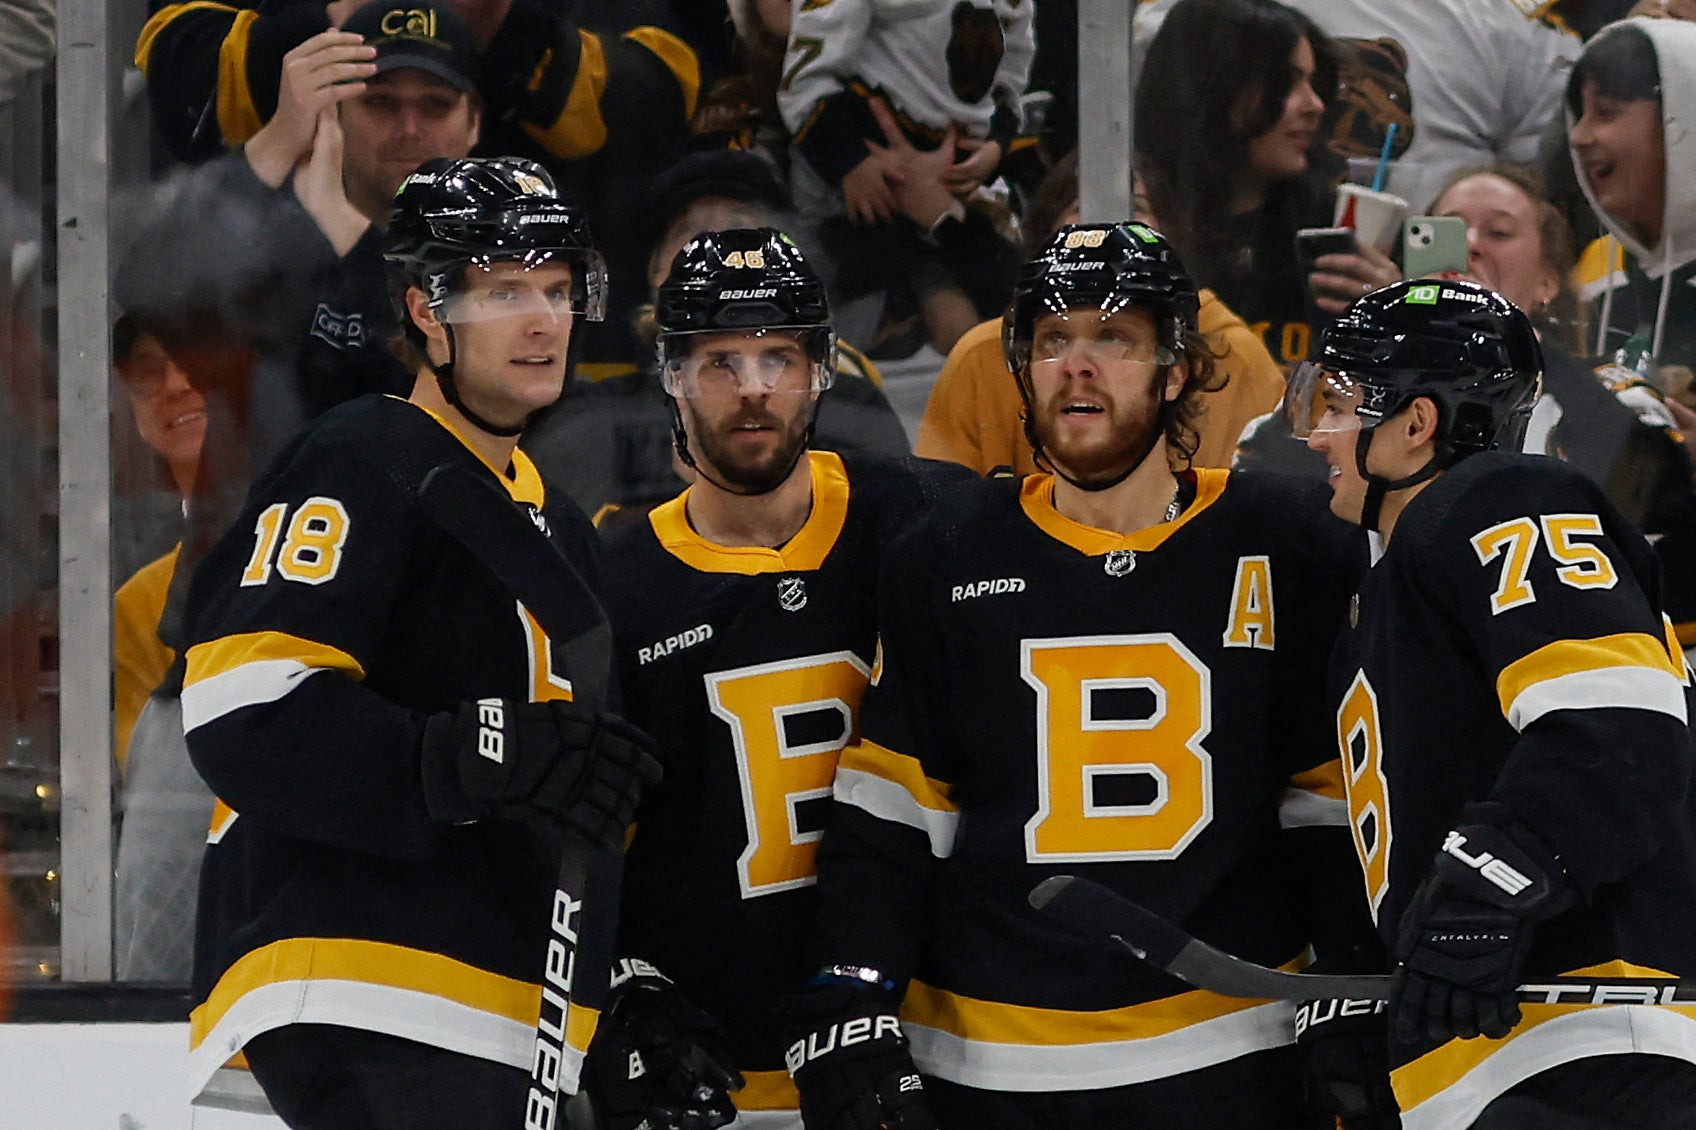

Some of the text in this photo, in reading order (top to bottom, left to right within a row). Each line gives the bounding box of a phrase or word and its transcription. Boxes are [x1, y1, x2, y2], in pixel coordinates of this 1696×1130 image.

[381, 8, 438, 38] cal
[1064, 229, 1107, 249] 88
[724, 250, 766, 270] 46
[1048, 261, 1106, 273] BAUER
[718, 288, 778, 300] BAUER
[1441, 288, 1490, 306] Bank
[239, 496, 351, 588] 18
[1469, 513, 1619, 616] 75
[1222, 555, 1275, 652] A
[1020, 632, 1213, 865] B
[1336, 667, 1393, 929] B
[1442, 830, 1534, 897] UE
[628, 1050, 647, 1080] B
